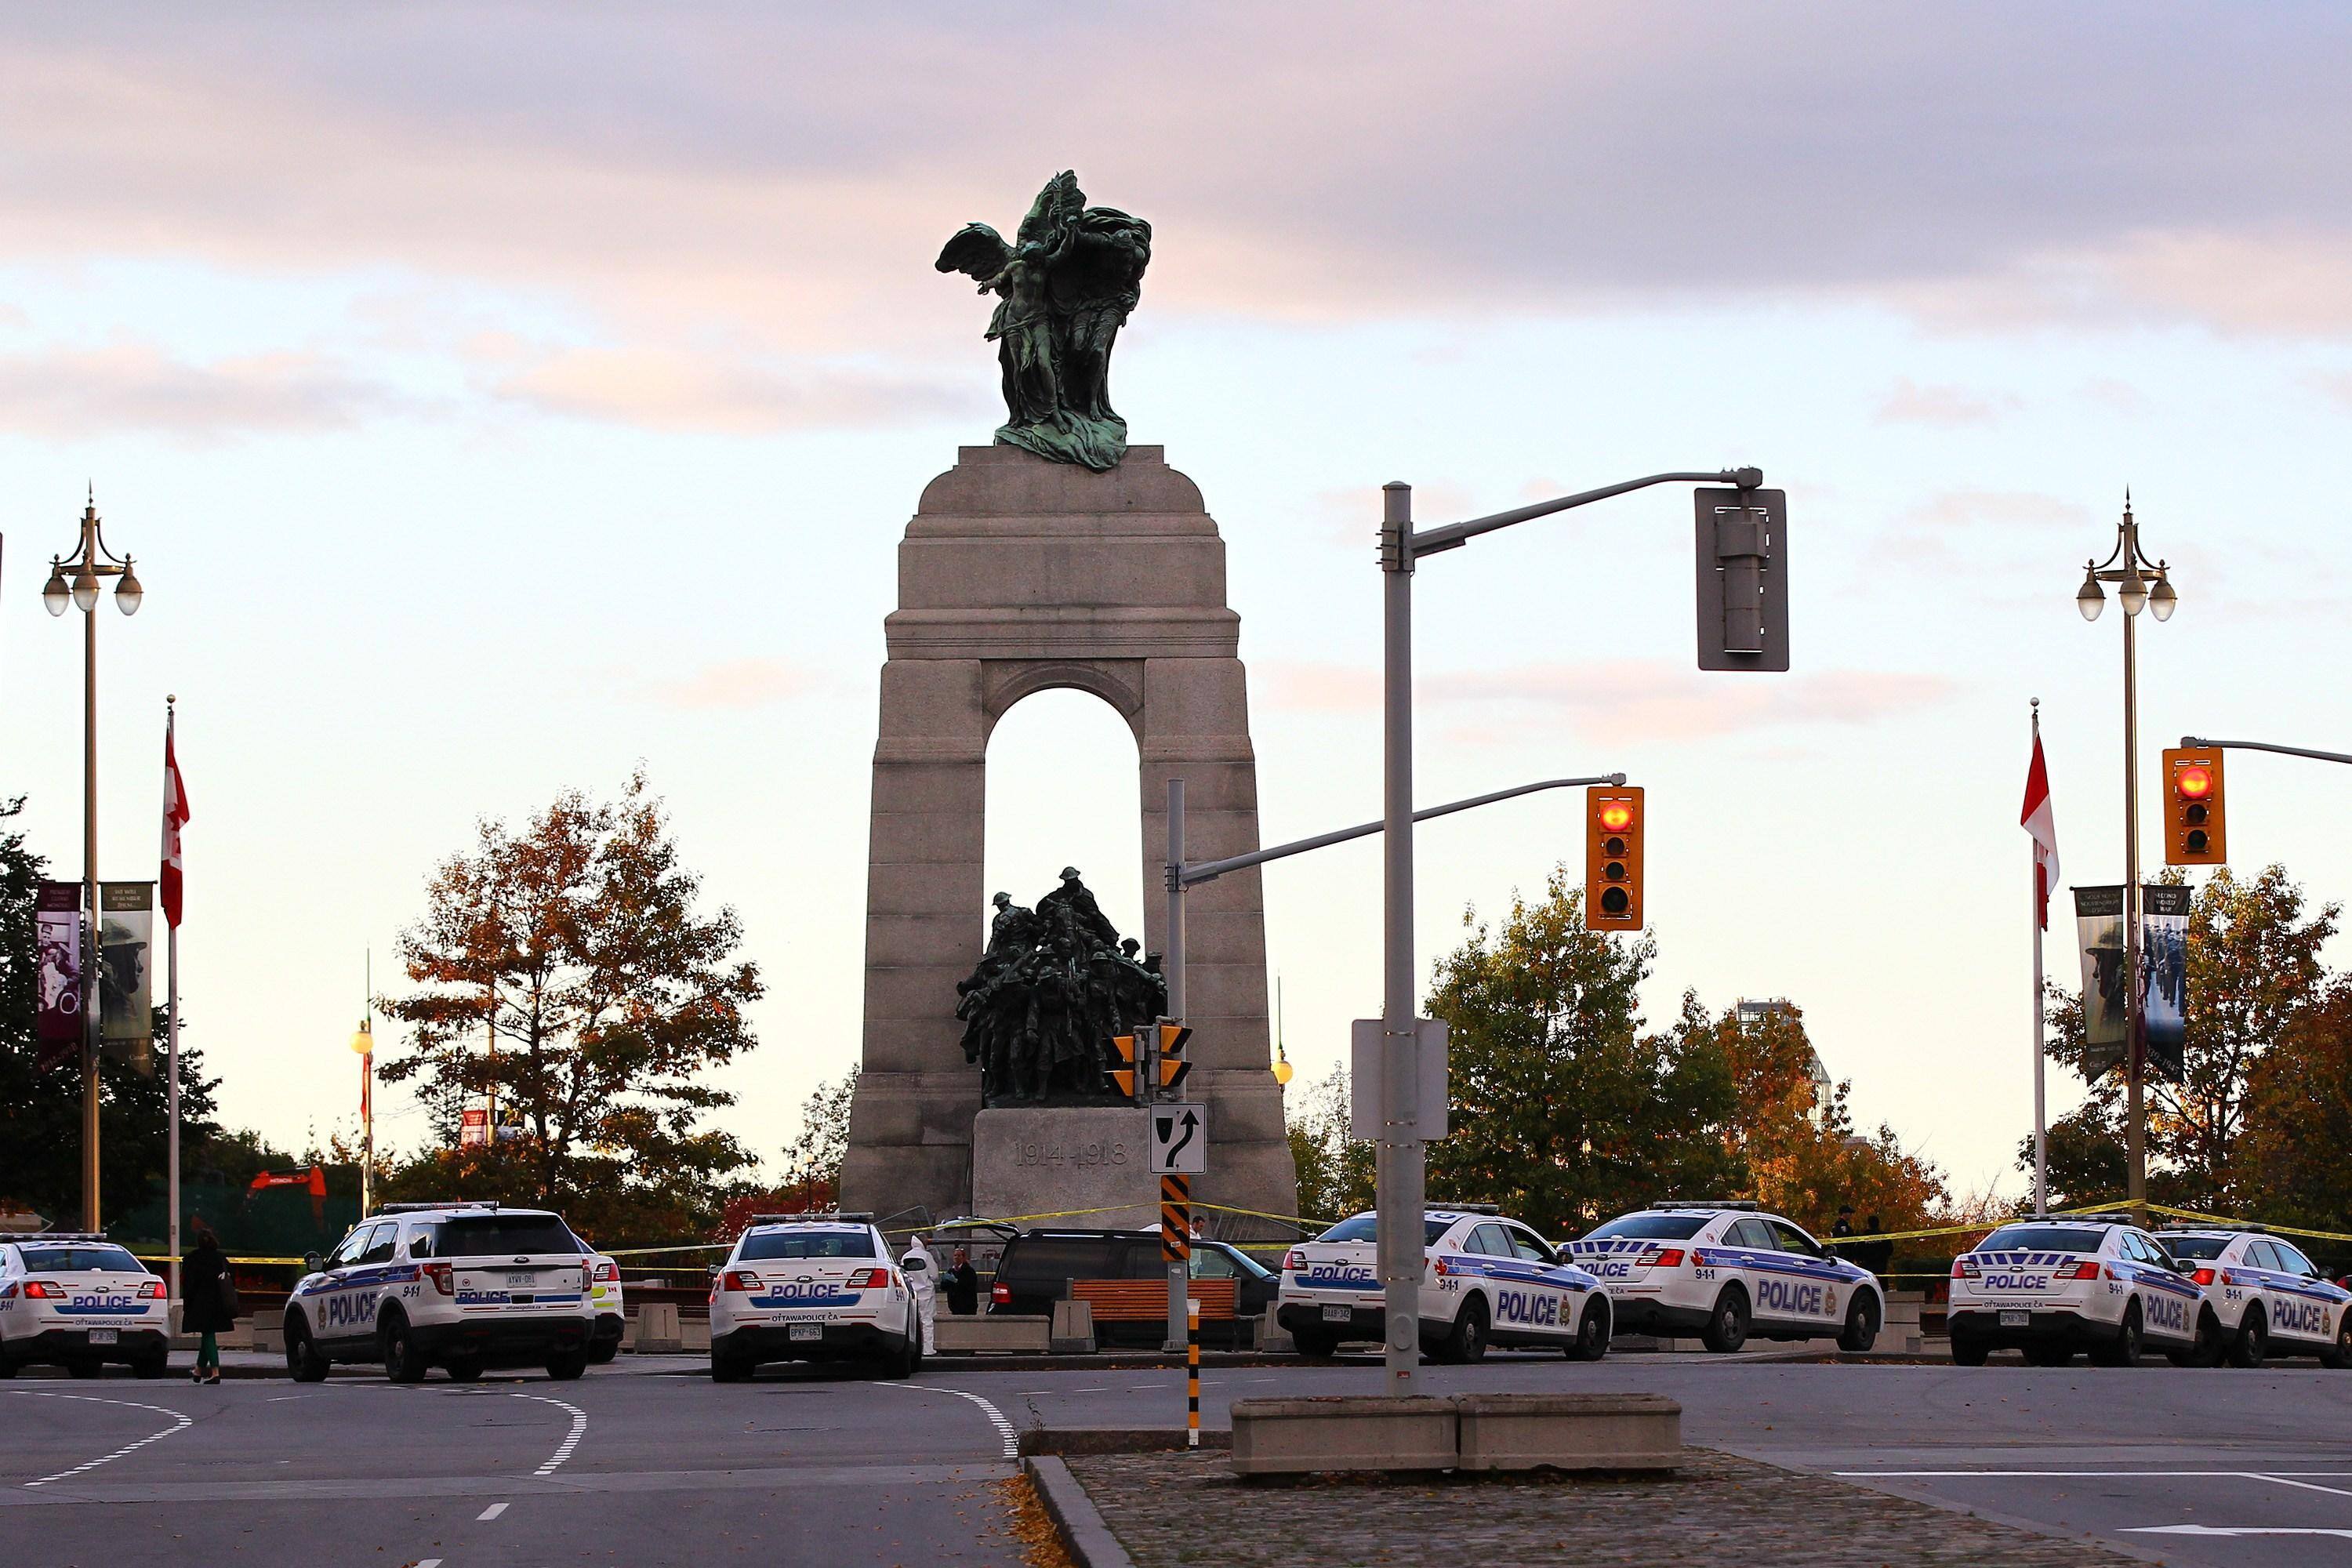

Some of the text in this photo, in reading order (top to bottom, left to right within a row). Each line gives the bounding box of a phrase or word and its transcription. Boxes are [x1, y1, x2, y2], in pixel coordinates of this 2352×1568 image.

[1014, 1142, 1128, 1166] 1914-1918
[1311, 1266, 1373, 1282] POLICE
[1696, 1269, 1715, 1280] 9-1-1
[1439, 1279, 1459, 1290] 9-1-1
[1984, 1275, 2048, 1290] POLICE
[402, 1286, 420, 1298] 9-1-1
[459, 1291, 509, 1305] POLICE
[770, 1283, 840, 1300] POLICE
[1755, 1279, 1822, 1316] POLICE
[73, 1296, 133, 1309] POLICE
[329, 1290, 378, 1327] POLICE
[1496, 1290, 1558, 1327] POLICE
[772, 1314, 839, 1323] OTTAWAPOLICE.CA
[2147, 1294, 2183, 1331] POLICE
[2273, 1298, 2321, 1334] POLICE
